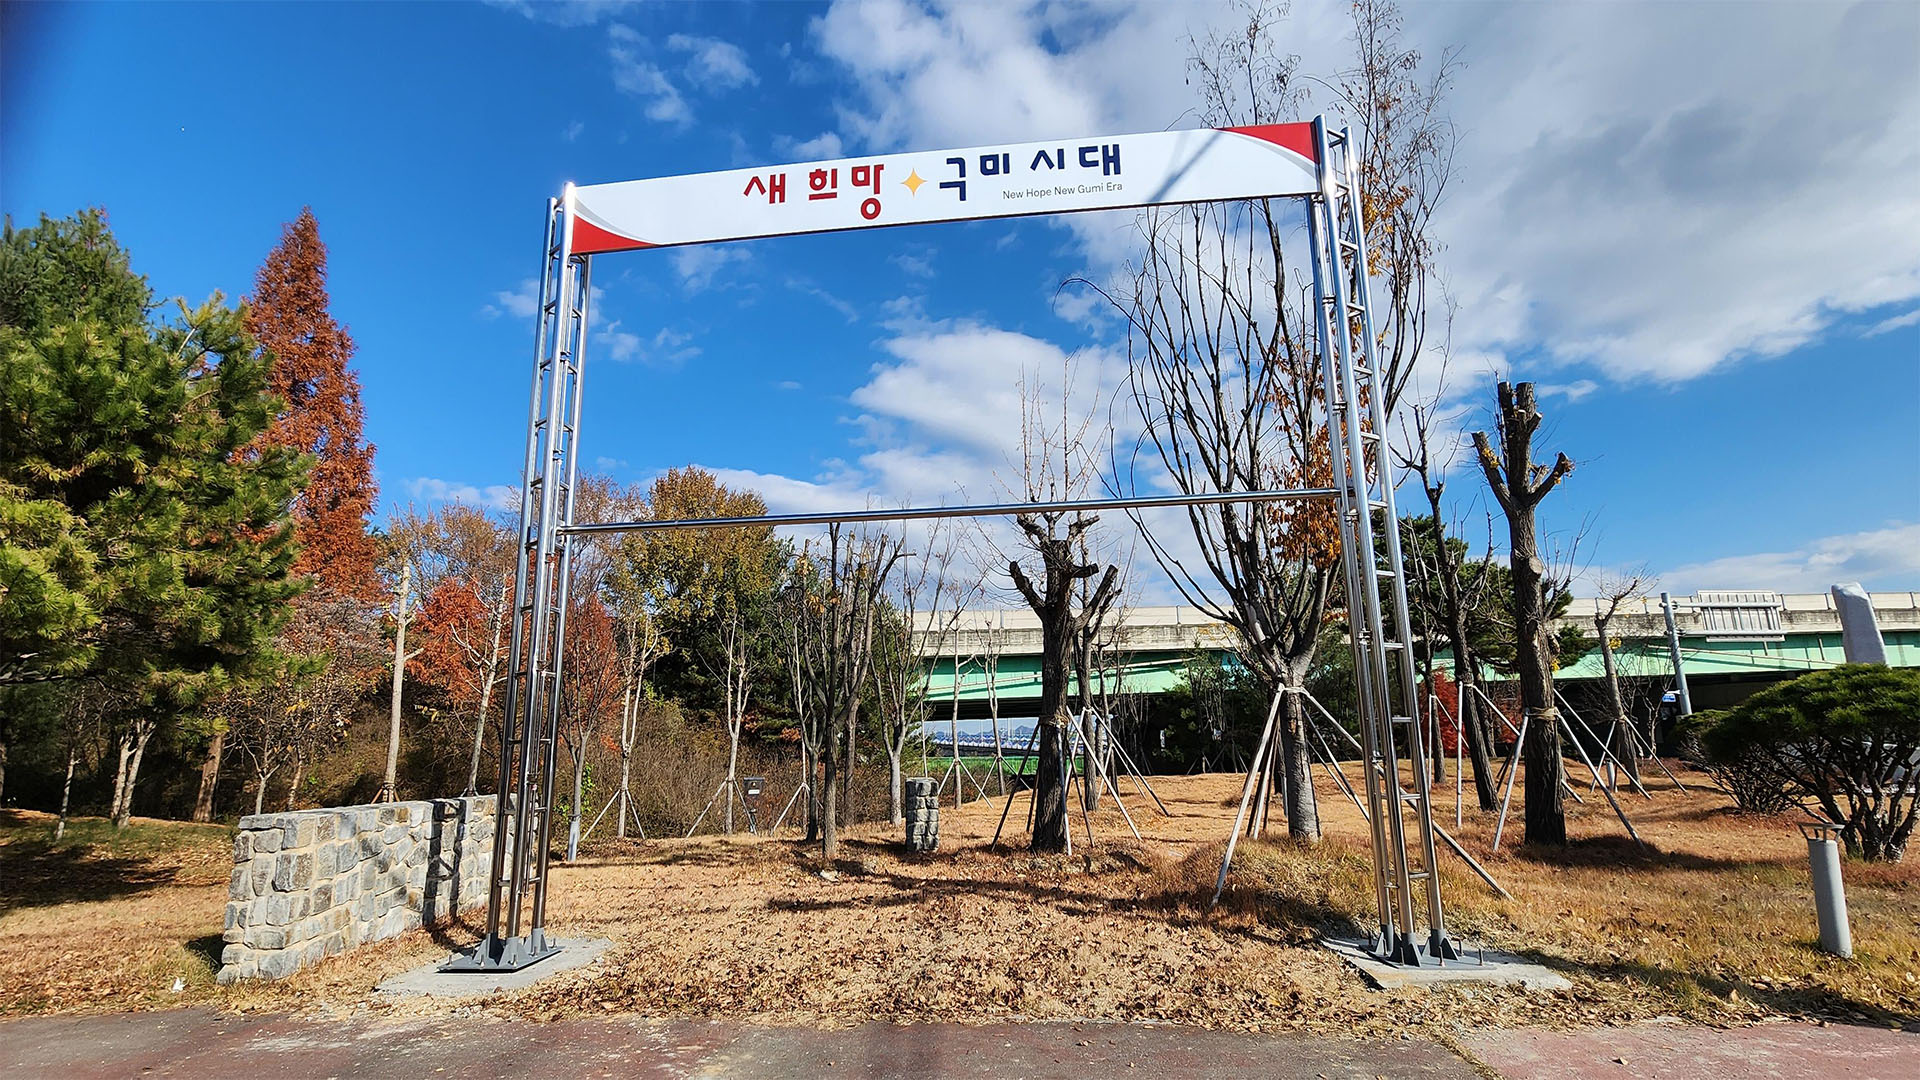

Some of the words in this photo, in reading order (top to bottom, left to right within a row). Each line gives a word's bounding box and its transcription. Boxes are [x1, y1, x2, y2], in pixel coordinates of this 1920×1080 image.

[743, 172, 786, 205] 새
[808, 163, 885, 220] 희망
[939, 152, 1011, 202] 구미
[1029, 143, 1122, 177] 시대
[1002, 190, 1024, 200] New
[1026, 187, 1052, 199] Hope
[1054, 185, 1075, 196] New
[1077, 182, 1104, 194] Gumi
[1106, 181, 1123, 192] Era
